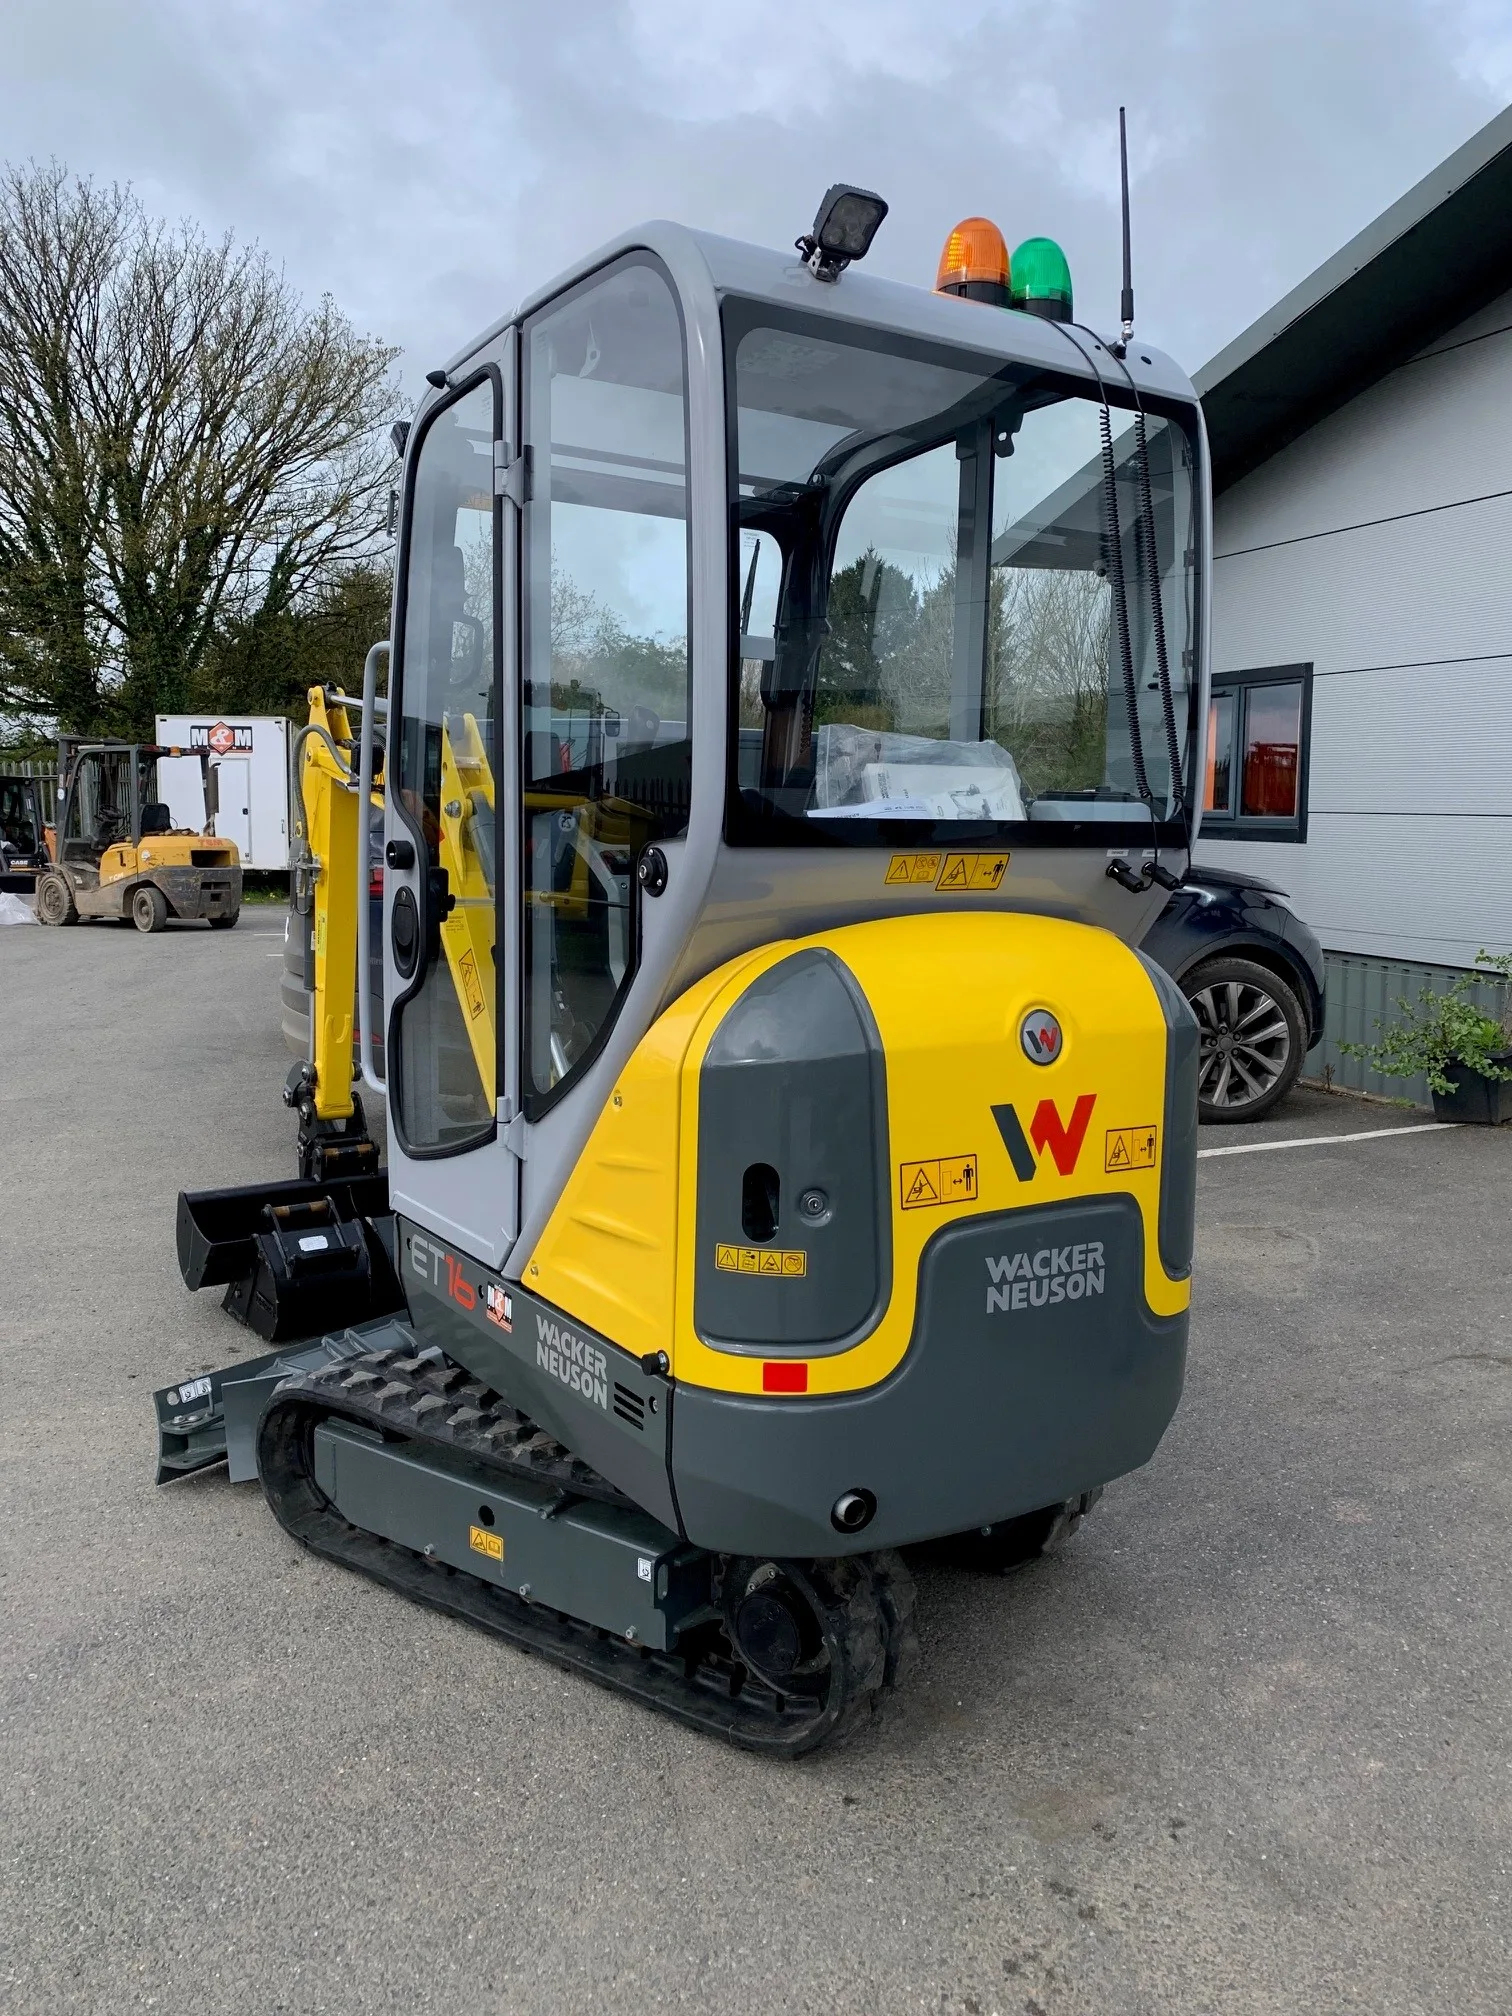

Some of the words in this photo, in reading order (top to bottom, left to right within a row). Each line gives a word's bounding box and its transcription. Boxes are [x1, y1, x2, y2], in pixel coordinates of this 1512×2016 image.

[191, 728, 252, 747] M&M
[985, 1242, 1106, 1284] WACKER
[986, 1269, 1106, 1314] NEUSON
[535, 1314, 608, 1382] WACKER
[536, 1341, 608, 1411] NEUSON
